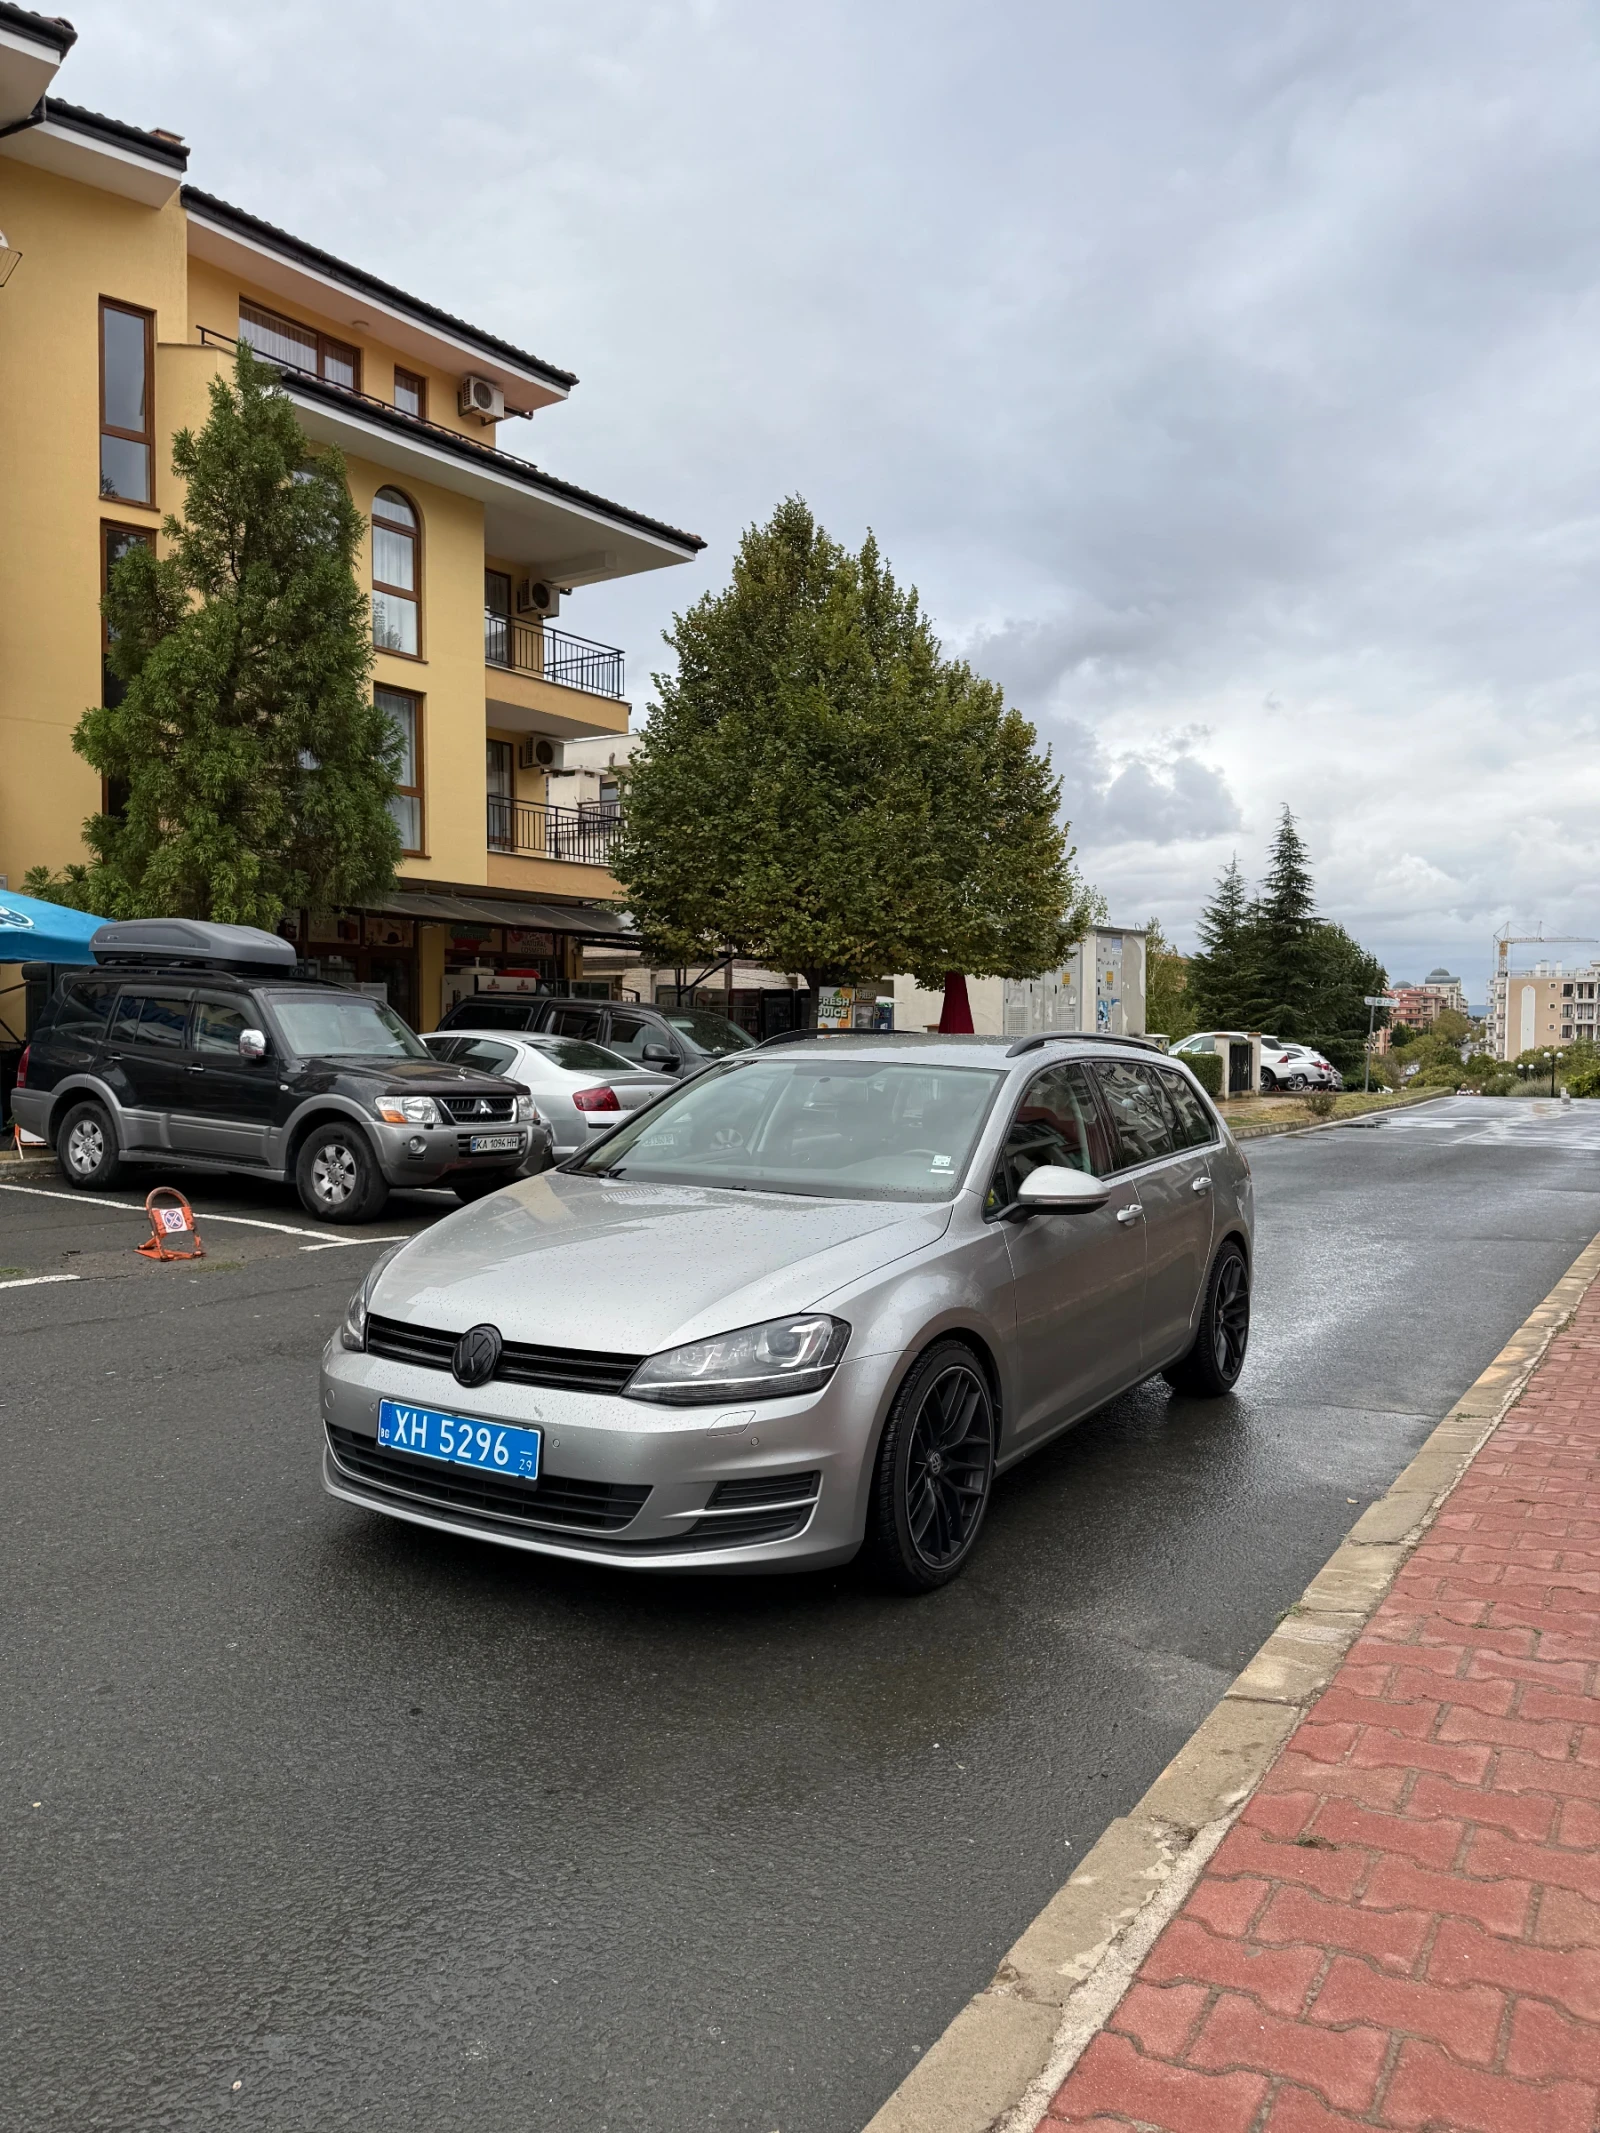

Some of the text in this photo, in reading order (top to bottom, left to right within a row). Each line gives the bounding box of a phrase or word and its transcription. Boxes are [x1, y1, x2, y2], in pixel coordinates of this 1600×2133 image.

[522, 940, 546, 948] NATURAL
[818, 1007, 848, 1017] JUICE
[476, 1137, 517, 1149] KA 1096 HH
[380, 1428, 390, 1439] BG
[393, 1409, 509, 1466] XH 5296
[518, 1458, 532, 1471] 29
